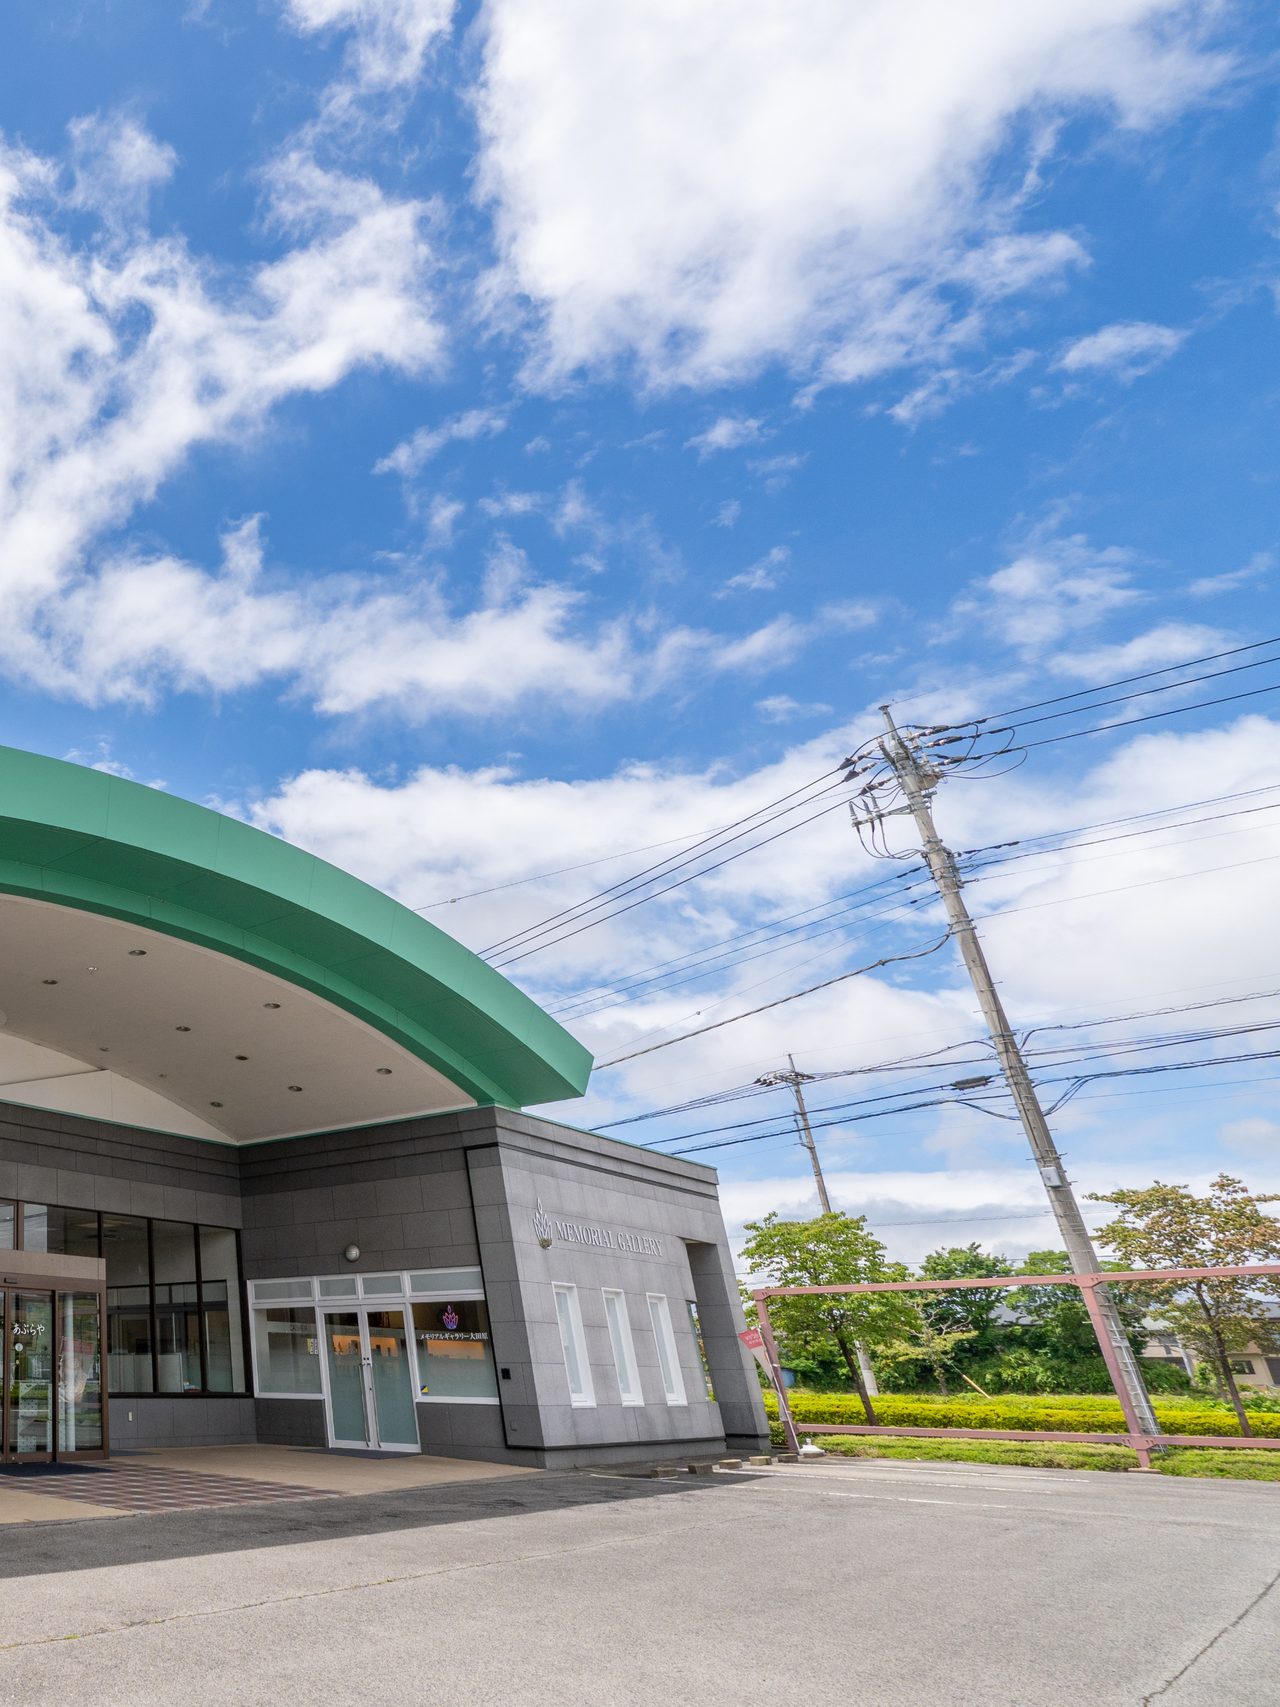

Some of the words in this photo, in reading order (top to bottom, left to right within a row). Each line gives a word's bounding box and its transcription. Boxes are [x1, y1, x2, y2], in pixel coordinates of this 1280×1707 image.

[555, 1220, 617, 1249] MEMORIAL
[617, 1231, 664, 1257] GALLERY
[13, 1323, 46, 1336] あぶらや
